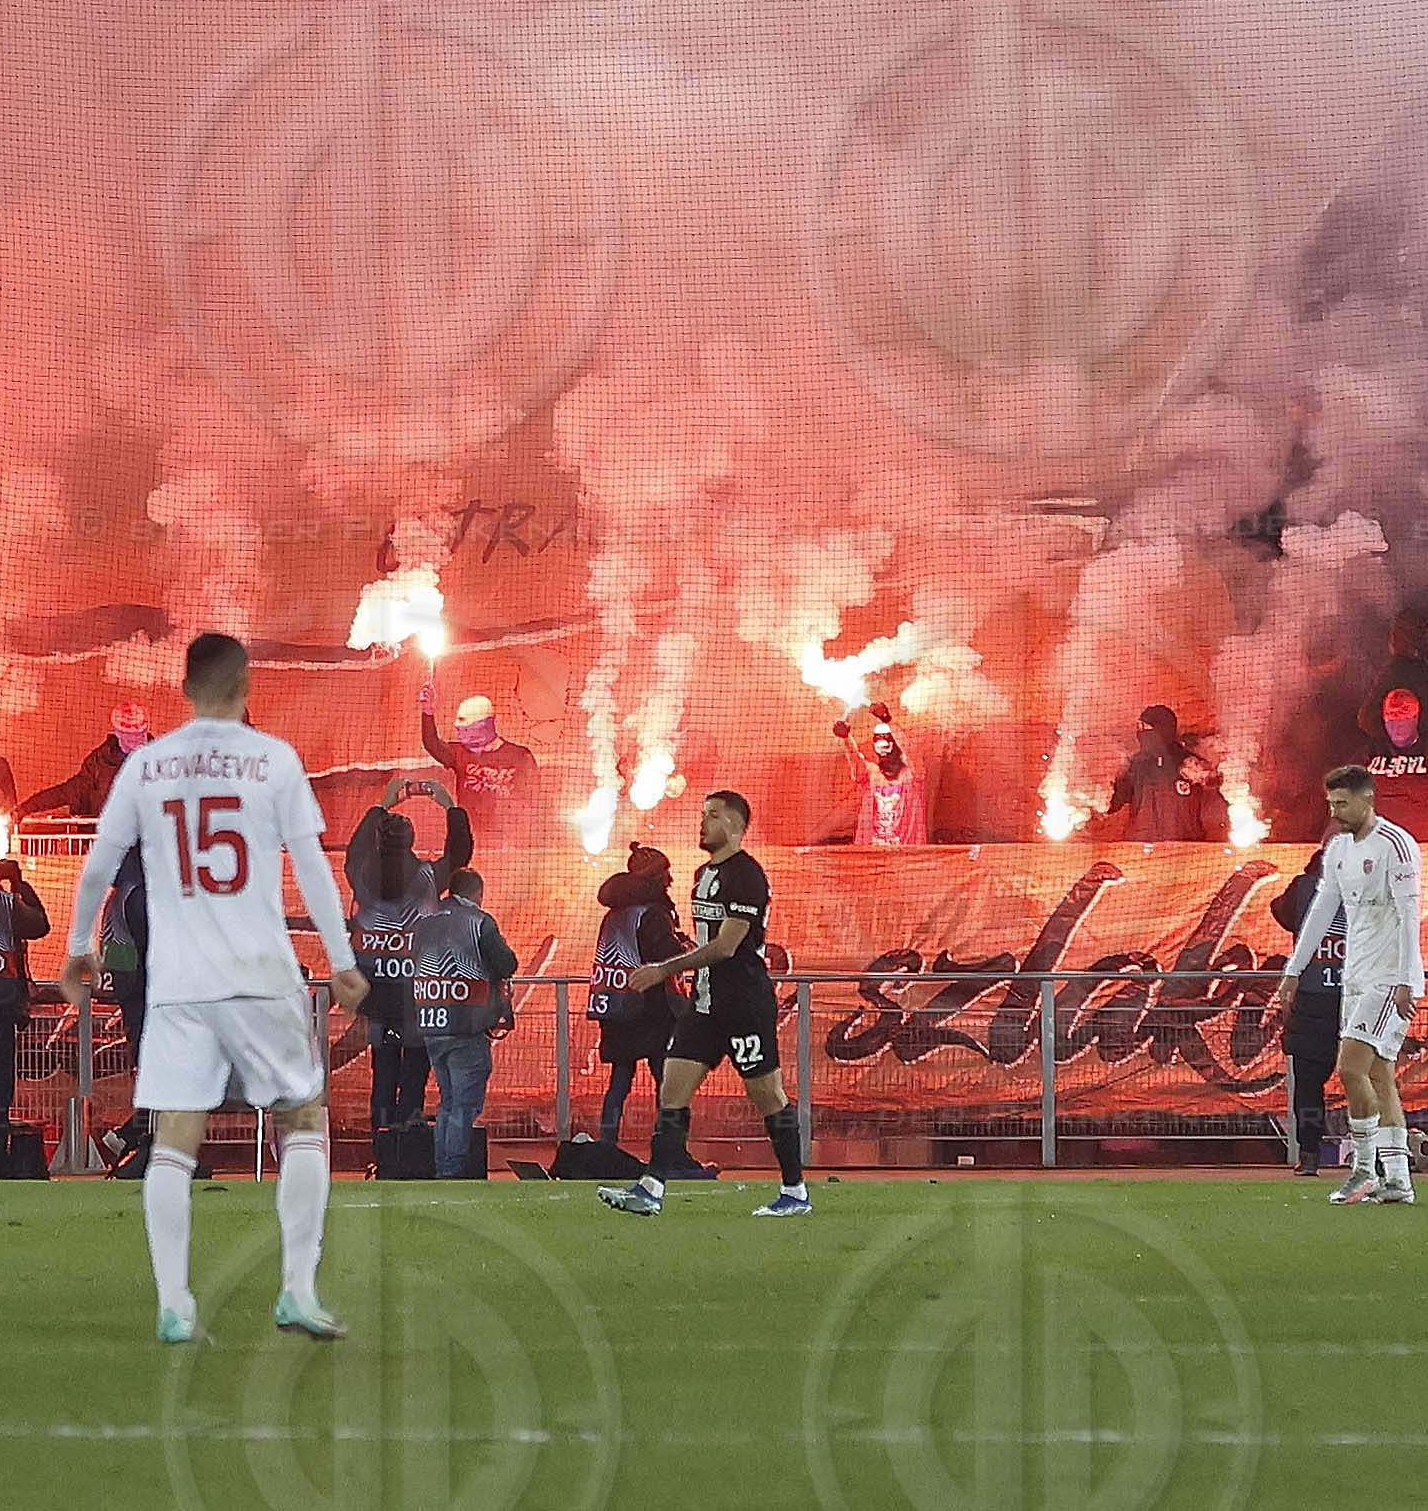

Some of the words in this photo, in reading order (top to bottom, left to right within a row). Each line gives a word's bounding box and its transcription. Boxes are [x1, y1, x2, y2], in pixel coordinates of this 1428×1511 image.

[162, 795, 249, 897] 15
[374, 957, 416, 978] 100
[413, 979, 469, 1002] PHOTO
[419, 1007, 448, 1028] 118
[730, 1034, 764, 1064] 22
